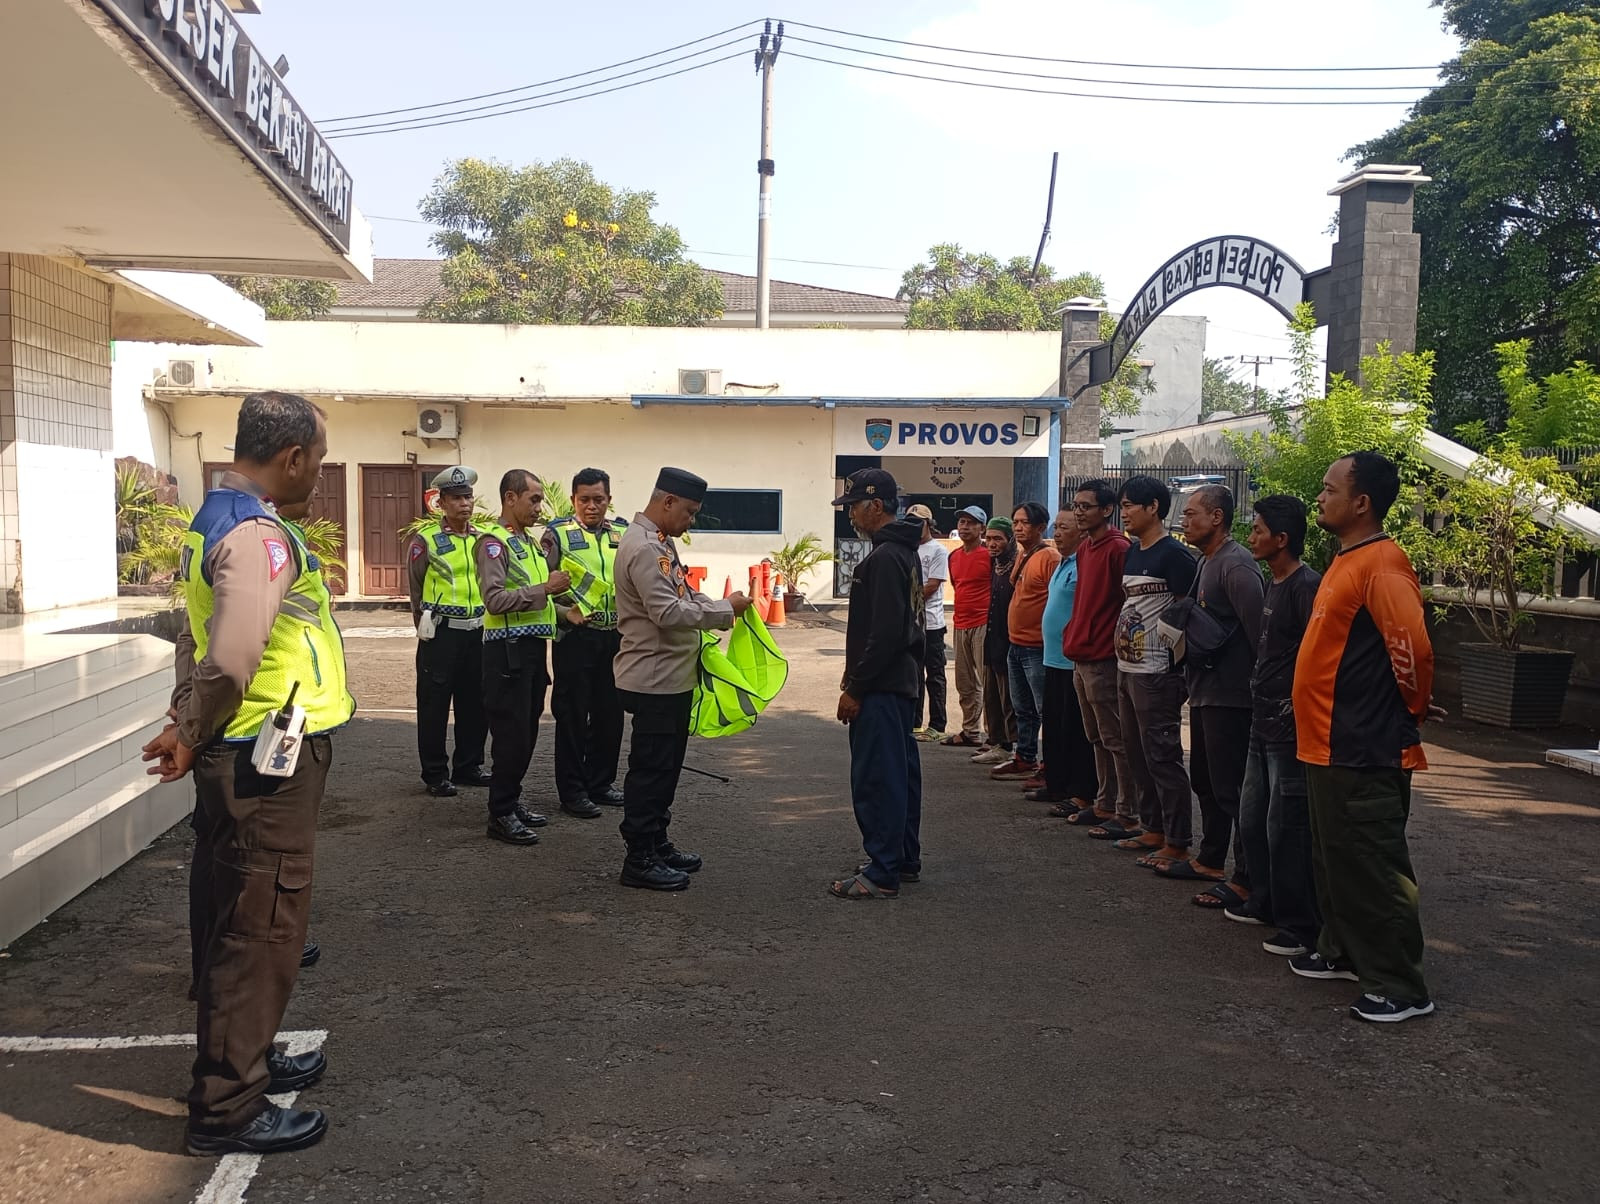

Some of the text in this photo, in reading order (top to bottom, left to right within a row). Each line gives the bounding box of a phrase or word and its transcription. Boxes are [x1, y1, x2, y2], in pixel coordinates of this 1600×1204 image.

[160, 0, 350, 224] LSEK BEKASI BARAT
[898, 422, 1019, 446] PROVOS
[933, 466, 962, 475] POLSEK
